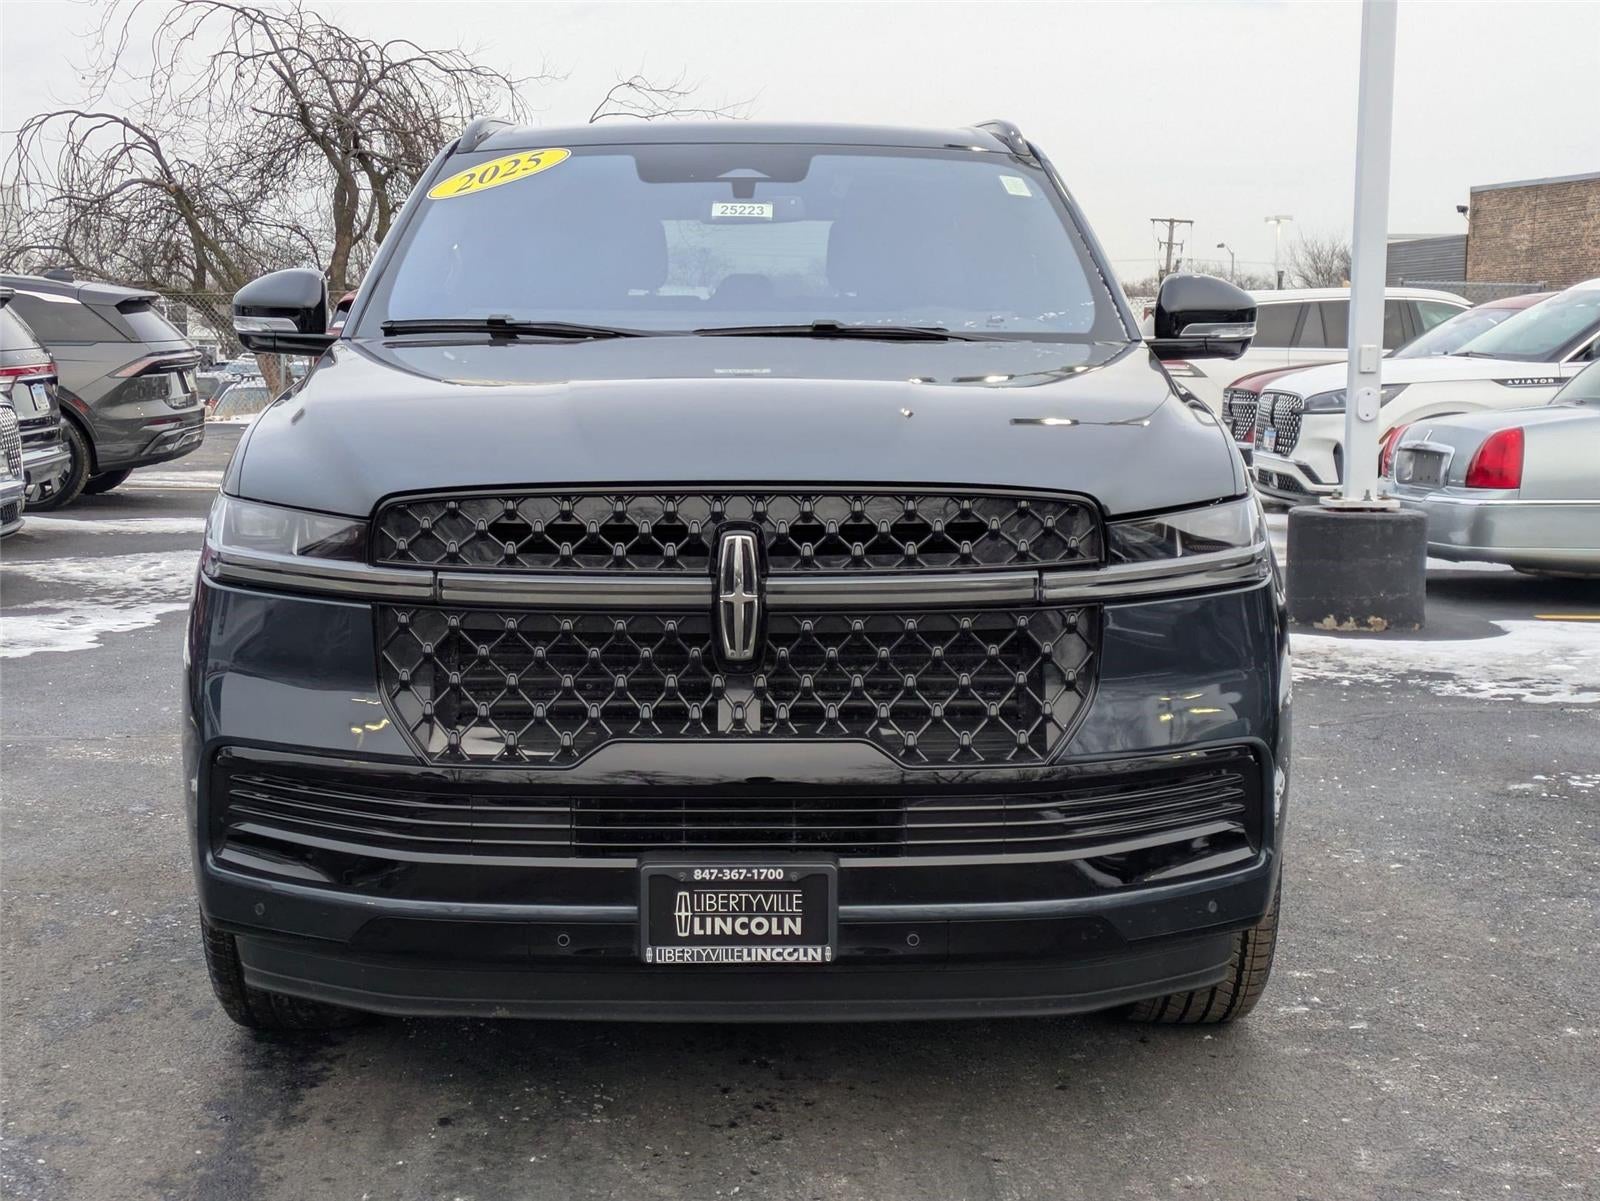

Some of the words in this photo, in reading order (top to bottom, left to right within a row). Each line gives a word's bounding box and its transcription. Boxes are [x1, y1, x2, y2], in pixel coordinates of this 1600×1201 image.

[454, 151, 545, 194] 2025
[720, 204, 765, 216] 25223
[693, 868, 784, 881] 847-367-1700
[694, 893, 803, 912] LIBERTYVILLE
[693, 916, 802, 936] LINCOLN
